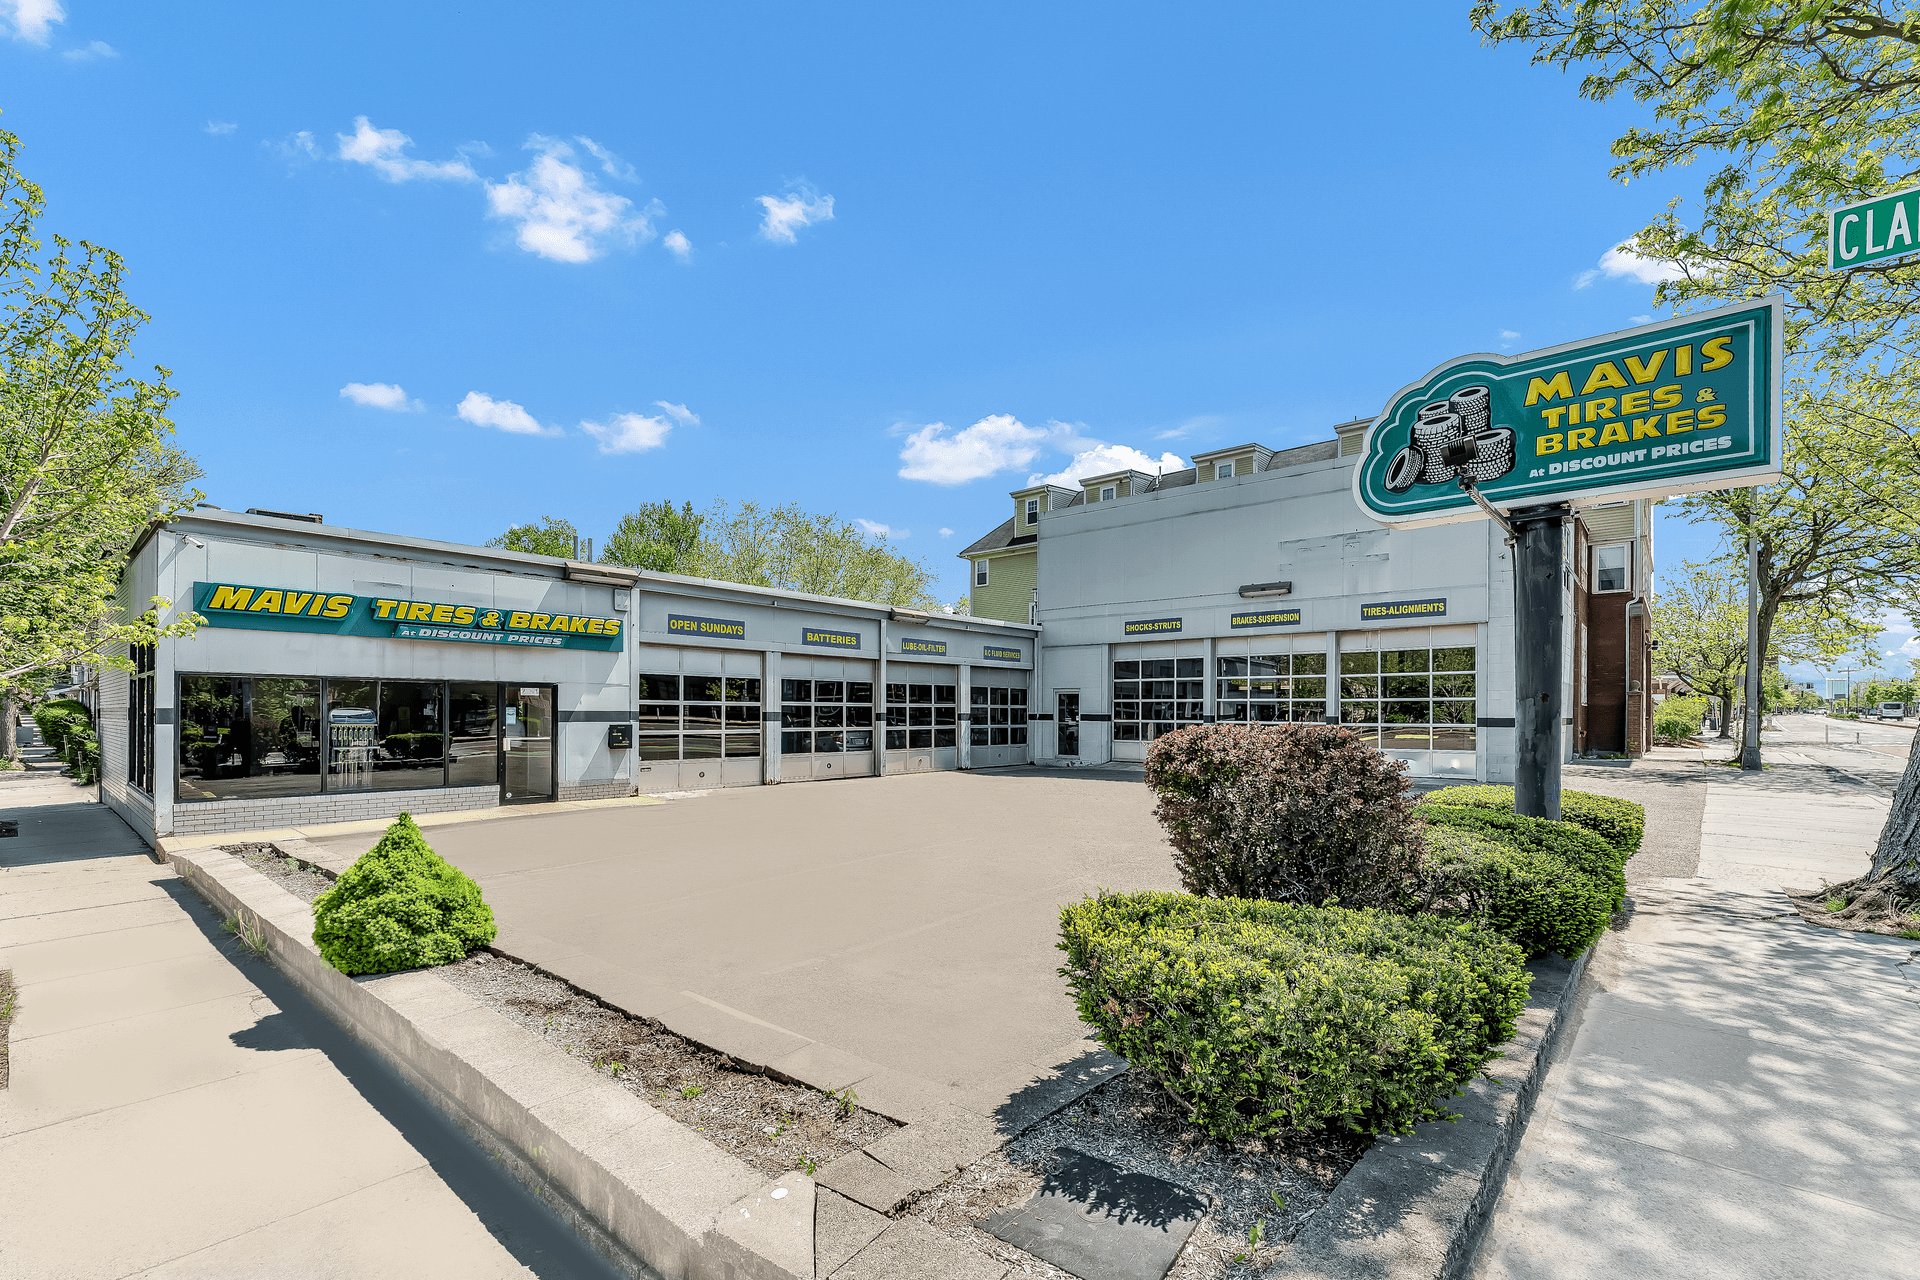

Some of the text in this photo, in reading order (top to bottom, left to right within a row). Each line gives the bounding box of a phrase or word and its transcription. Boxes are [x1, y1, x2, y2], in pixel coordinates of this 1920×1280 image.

[1839, 196, 1920, 260] CLA
[1523, 335, 1735, 408] MAVIS
[1540, 384, 1719, 429] TIRES &
[1535, 404, 1727, 457] BRAKES
[1548, 448, 1648, 475] DISCOUNT
[1651, 436, 1732, 459] PRICES
[208, 585, 354, 618] MAVIS
[1362, 602, 1445, 616] TIRES-ALIGNMENTS
[376, 599, 622, 635] TIRES & BRAKES
[1232, 612, 1300, 625] BRAKES-SUSPENSION
[669, 619, 744, 635] OPEN SUNDAYS
[1125, 621, 1181, 632] SHOCKS-STRUTS
[418, 628, 504, 642] DISCOUNT
[508, 635, 562, 645] PRICES
[806, 632, 857, 645] BATTERIES
[902, 641, 946, 653] LUBE-OIL-FILTER
[1002, 650, 1021, 659] SERVICES
